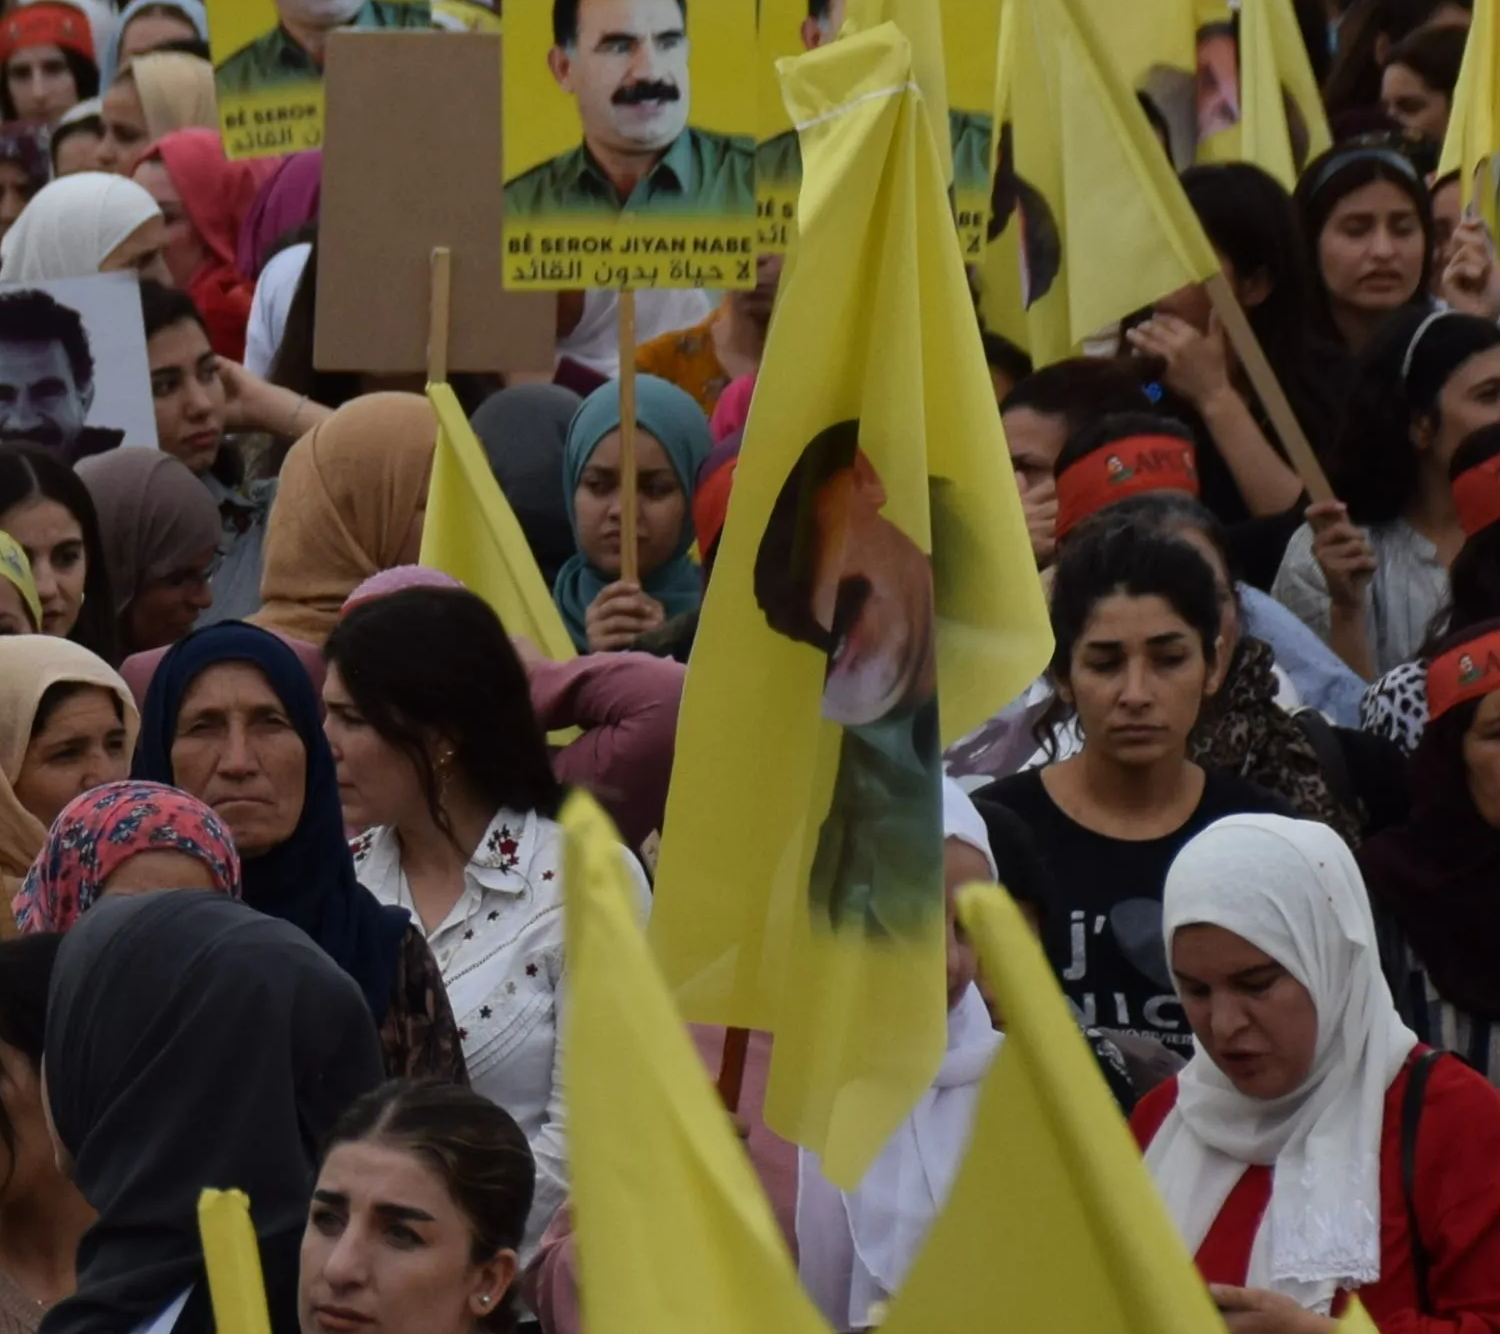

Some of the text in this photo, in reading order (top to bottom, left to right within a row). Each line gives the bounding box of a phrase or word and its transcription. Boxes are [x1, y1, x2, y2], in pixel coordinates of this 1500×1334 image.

[508, 231, 752, 254] BÊ SEROK JIYAN NABE
[511, 257, 751, 288] لا حياة بدون القائد
